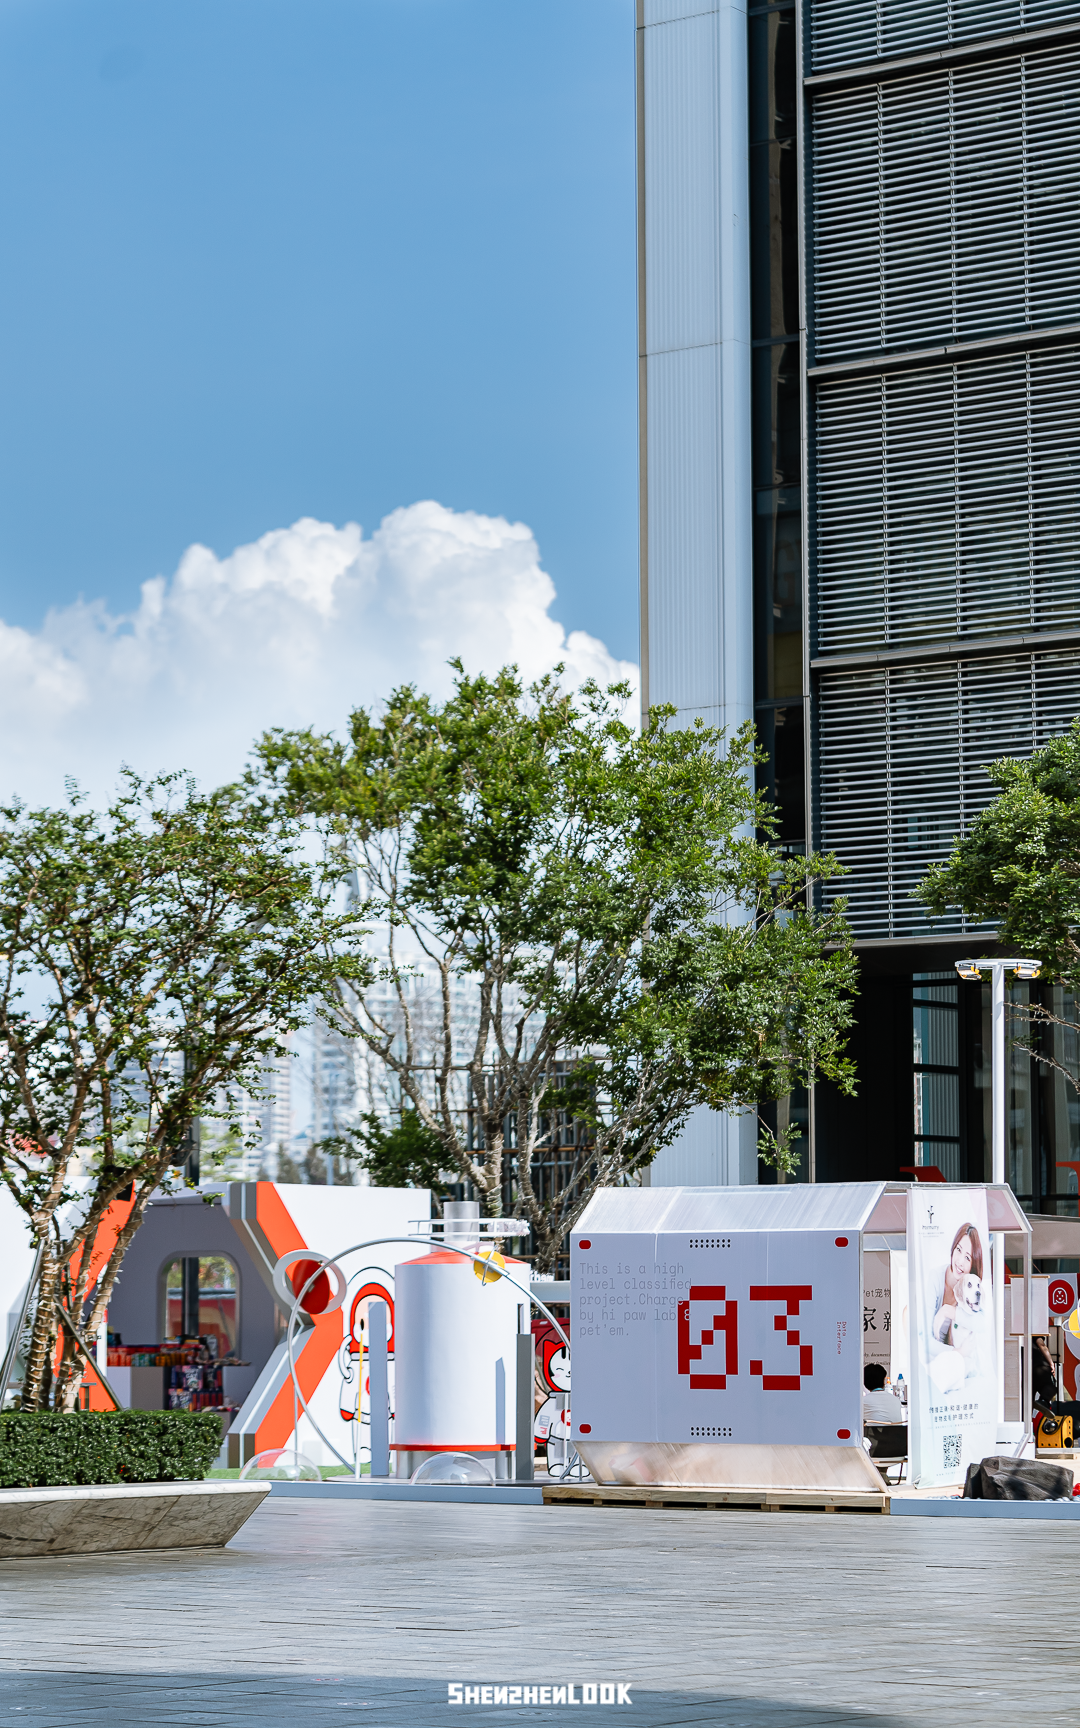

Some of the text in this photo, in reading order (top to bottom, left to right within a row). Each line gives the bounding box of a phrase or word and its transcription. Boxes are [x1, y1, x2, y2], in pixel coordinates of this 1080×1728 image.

[579, 1262, 685, 1278] This is a high
[579, 1278, 692, 1290] level classified
[863, 1287, 891, 1298] et宠物
[579, 1293, 684, 1309] project.Charge
[579, 1309, 594, 1324] by
[601, 1309, 616, 1321] hi
[623, 1312, 647, 1324] paw
[654, 1309, 677, 1321] lab
[579, 1324, 630, 1339] pet'em.
[677, 1285, 814, 1391] 03
